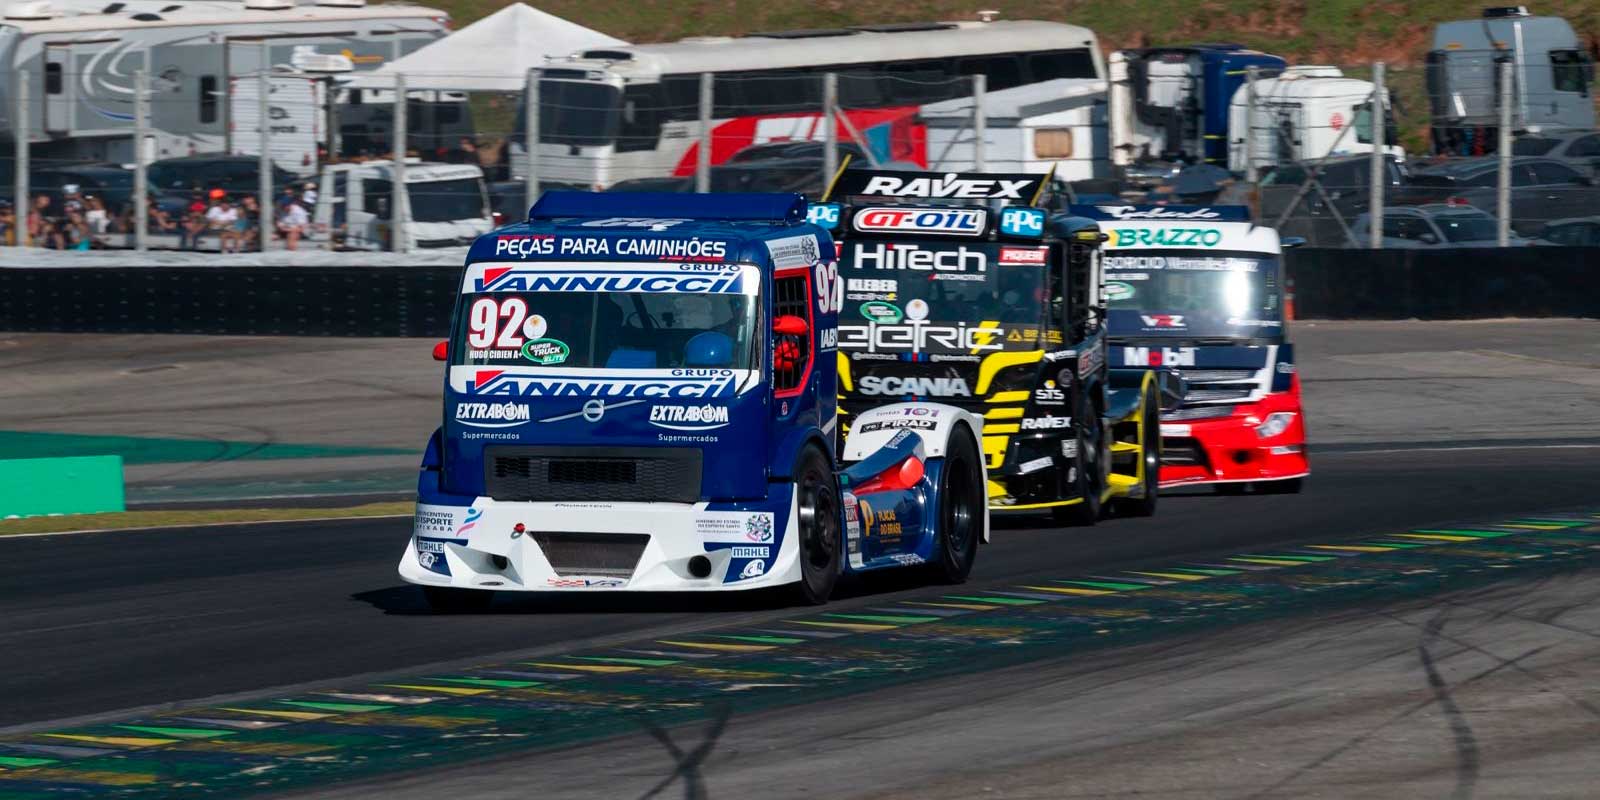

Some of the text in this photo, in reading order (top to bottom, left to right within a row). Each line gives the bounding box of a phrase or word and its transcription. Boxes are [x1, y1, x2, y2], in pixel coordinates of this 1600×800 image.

[862, 174, 1033, 198] RAVEX
[863, 211, 978, 228] GT-OIL
[1002, 211, 1042, 232] PPG
[1114, 228, 1221, 247] BRAZZO
[495, 237, 727, 259] PEÇAS PARA CAMINHÕES
[854, 243, 987, 272] HiTech
[679, 263, 741, 272] GRUPO
[474, 271, 735, 293] VANNUCCI
[816, 261, 838, 315] 92
[469, 297, 527, 349] 92
[530, 342, 551, 351] SUPER
[533, 347, 561, 356] TRUCK
[671, 369, 733, 377] GRUPO
[466, 375, 728, 398] VANNUCCI
[859, 376, 971, 397] SCANIA
[455, 401, 530, 421] EXTRABOM
[650, 403, 729, 423] EXTRABOM
[1021, 415, 1072, 429] RAVEX
[462, 431, 520, 440] Supermercados
[658, 433, 718, 442] Supermercados
[733, 547, 769, 557] MAHLE
